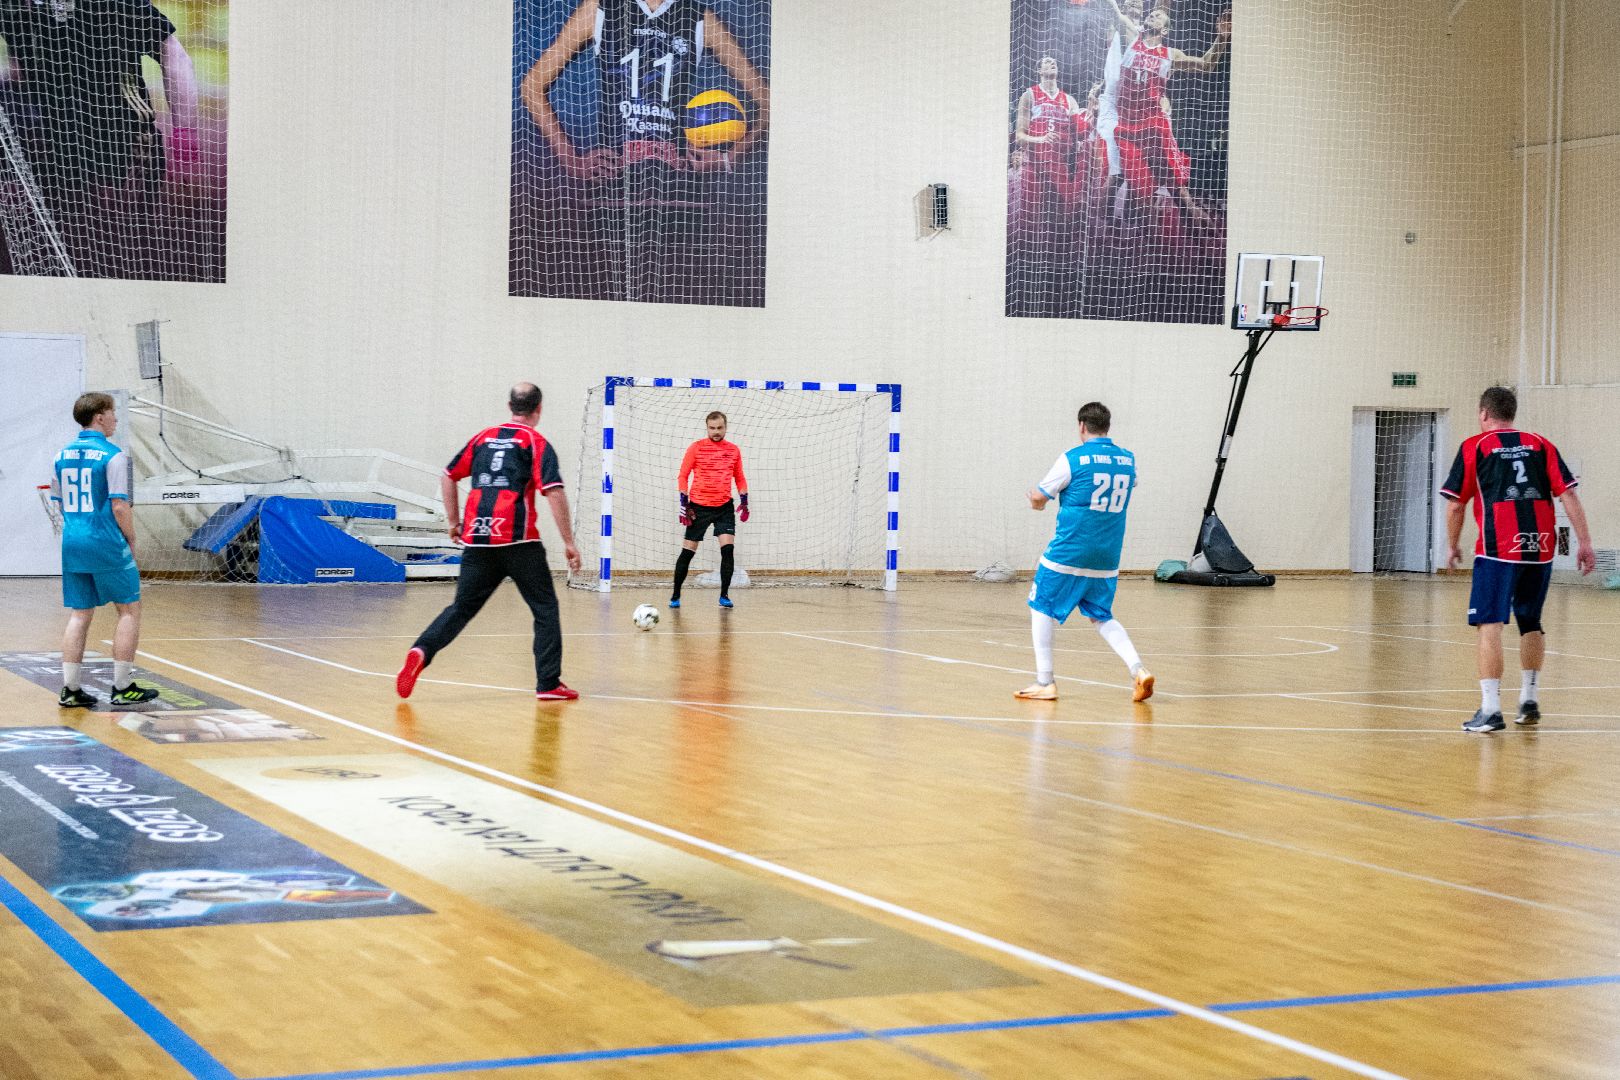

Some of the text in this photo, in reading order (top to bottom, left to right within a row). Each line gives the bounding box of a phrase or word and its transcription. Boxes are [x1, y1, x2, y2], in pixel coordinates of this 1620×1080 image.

[620, 48, 674, 103] 11
[61, 468, 94, 512] 69
[1090, 472, 1131, 513] 28
[1512, 460, 1528, 484] 2
